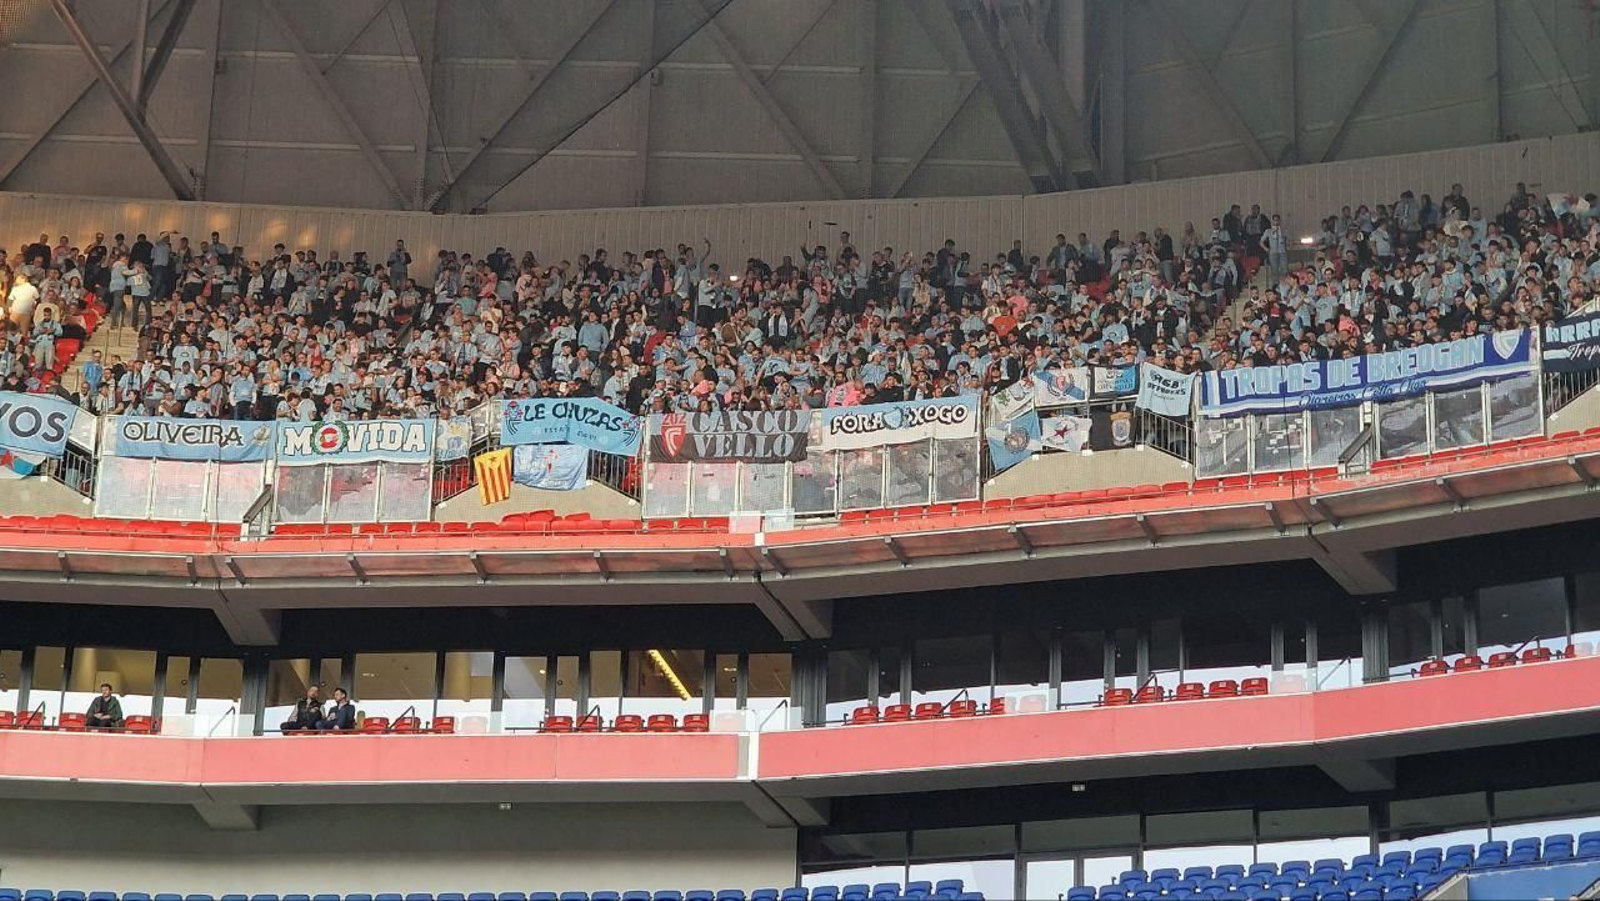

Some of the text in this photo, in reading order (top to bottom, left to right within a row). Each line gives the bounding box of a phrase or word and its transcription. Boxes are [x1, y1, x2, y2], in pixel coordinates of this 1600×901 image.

[1221, 361, 1321, 399] TROPAS
[1326, 356, 1361, 389] DE
[524, 402, 546, 422] LE
[691, 409, 798, 434] CASCO
[123, 421, 244, 447] OLIVEIRA
[284, 420, 426, 455] MOVIDA
[692, 432, 795, 458] VELLO
